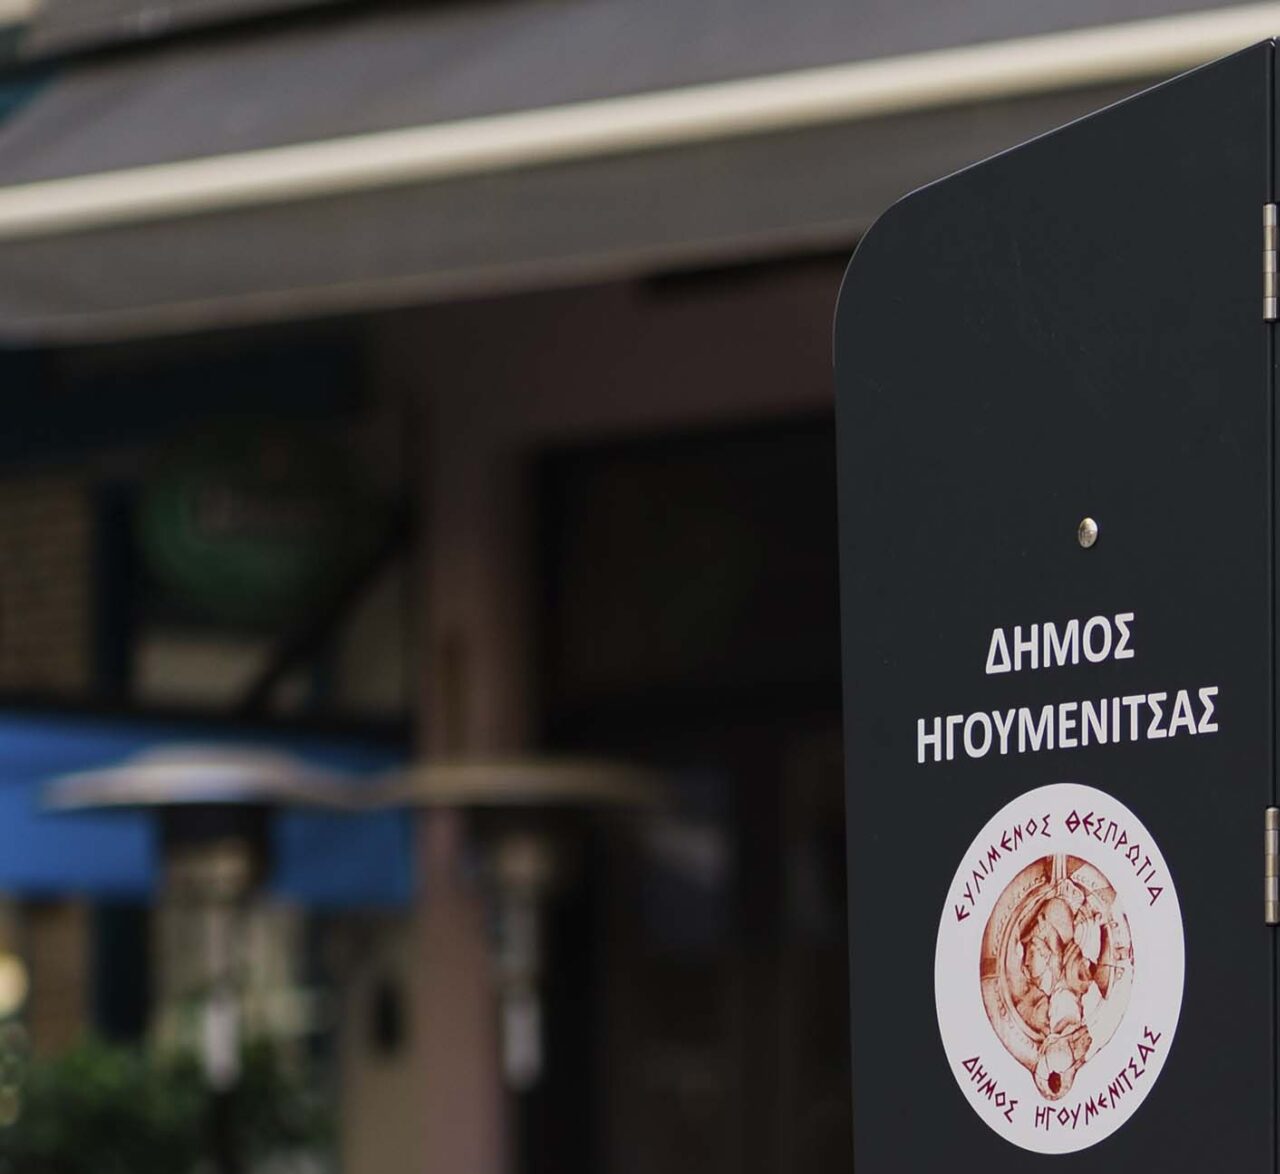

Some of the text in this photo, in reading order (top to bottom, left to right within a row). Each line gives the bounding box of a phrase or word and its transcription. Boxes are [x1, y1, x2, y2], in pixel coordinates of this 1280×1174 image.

[985, 612, 1135, 674] ΔΗΜΟΣ
[917, 686, 1219, 763] ΗΓΟΥΜΕΝΙΤΣΑΣ
[962, 1026, 1162, 1131] ΔΗΜΟΣ ΗΓΟΥΜΕΝΙΤΣΑΣ
